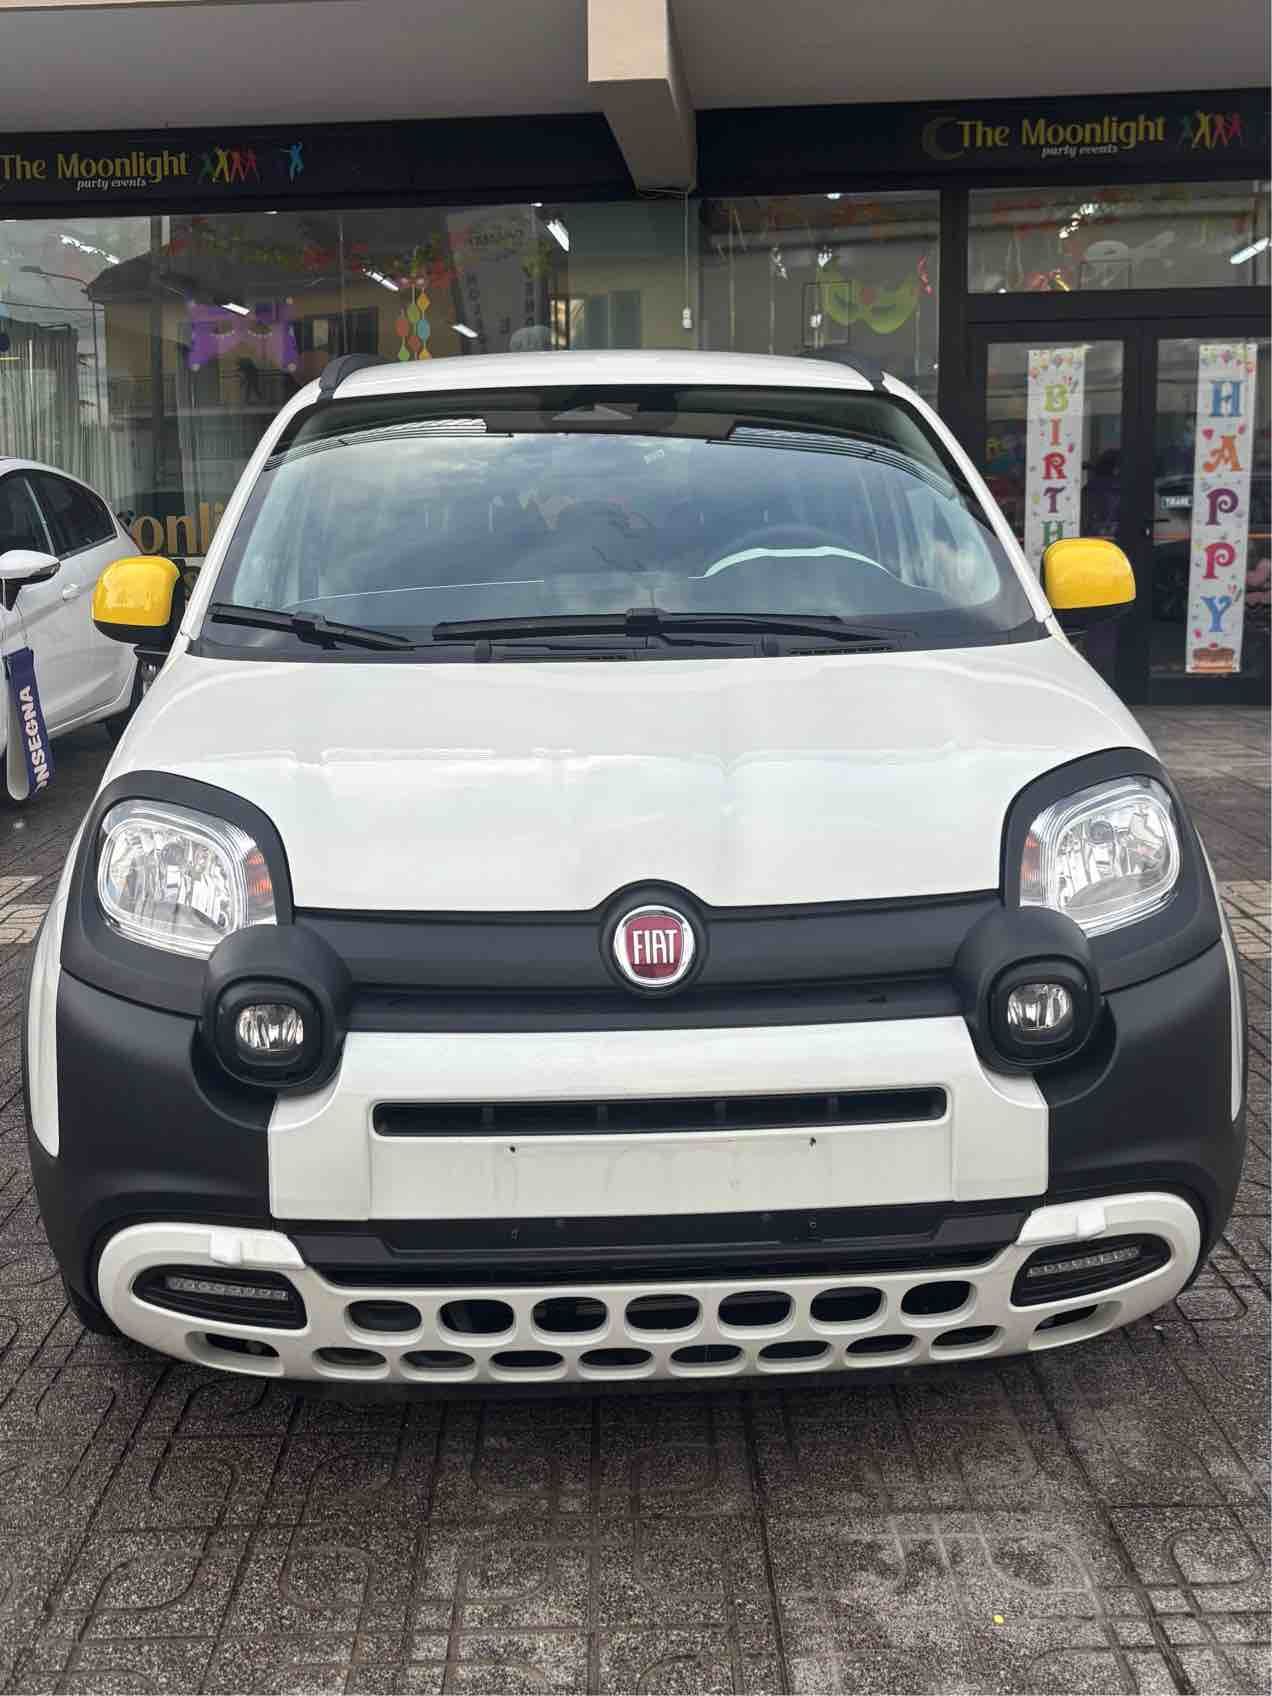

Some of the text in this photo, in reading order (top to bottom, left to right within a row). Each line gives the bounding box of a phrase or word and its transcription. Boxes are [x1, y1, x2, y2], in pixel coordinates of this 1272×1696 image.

[957, 114, 1165, 149] The Moonlight
[0, 150, 190, 183] The Moonlight
[1041, 144, 1118, 158] party events
[76, 176, 147, 192] party events
[1200, 380, 1244, 633] HAPPY
[632, 929, 678, 965] FIAT
